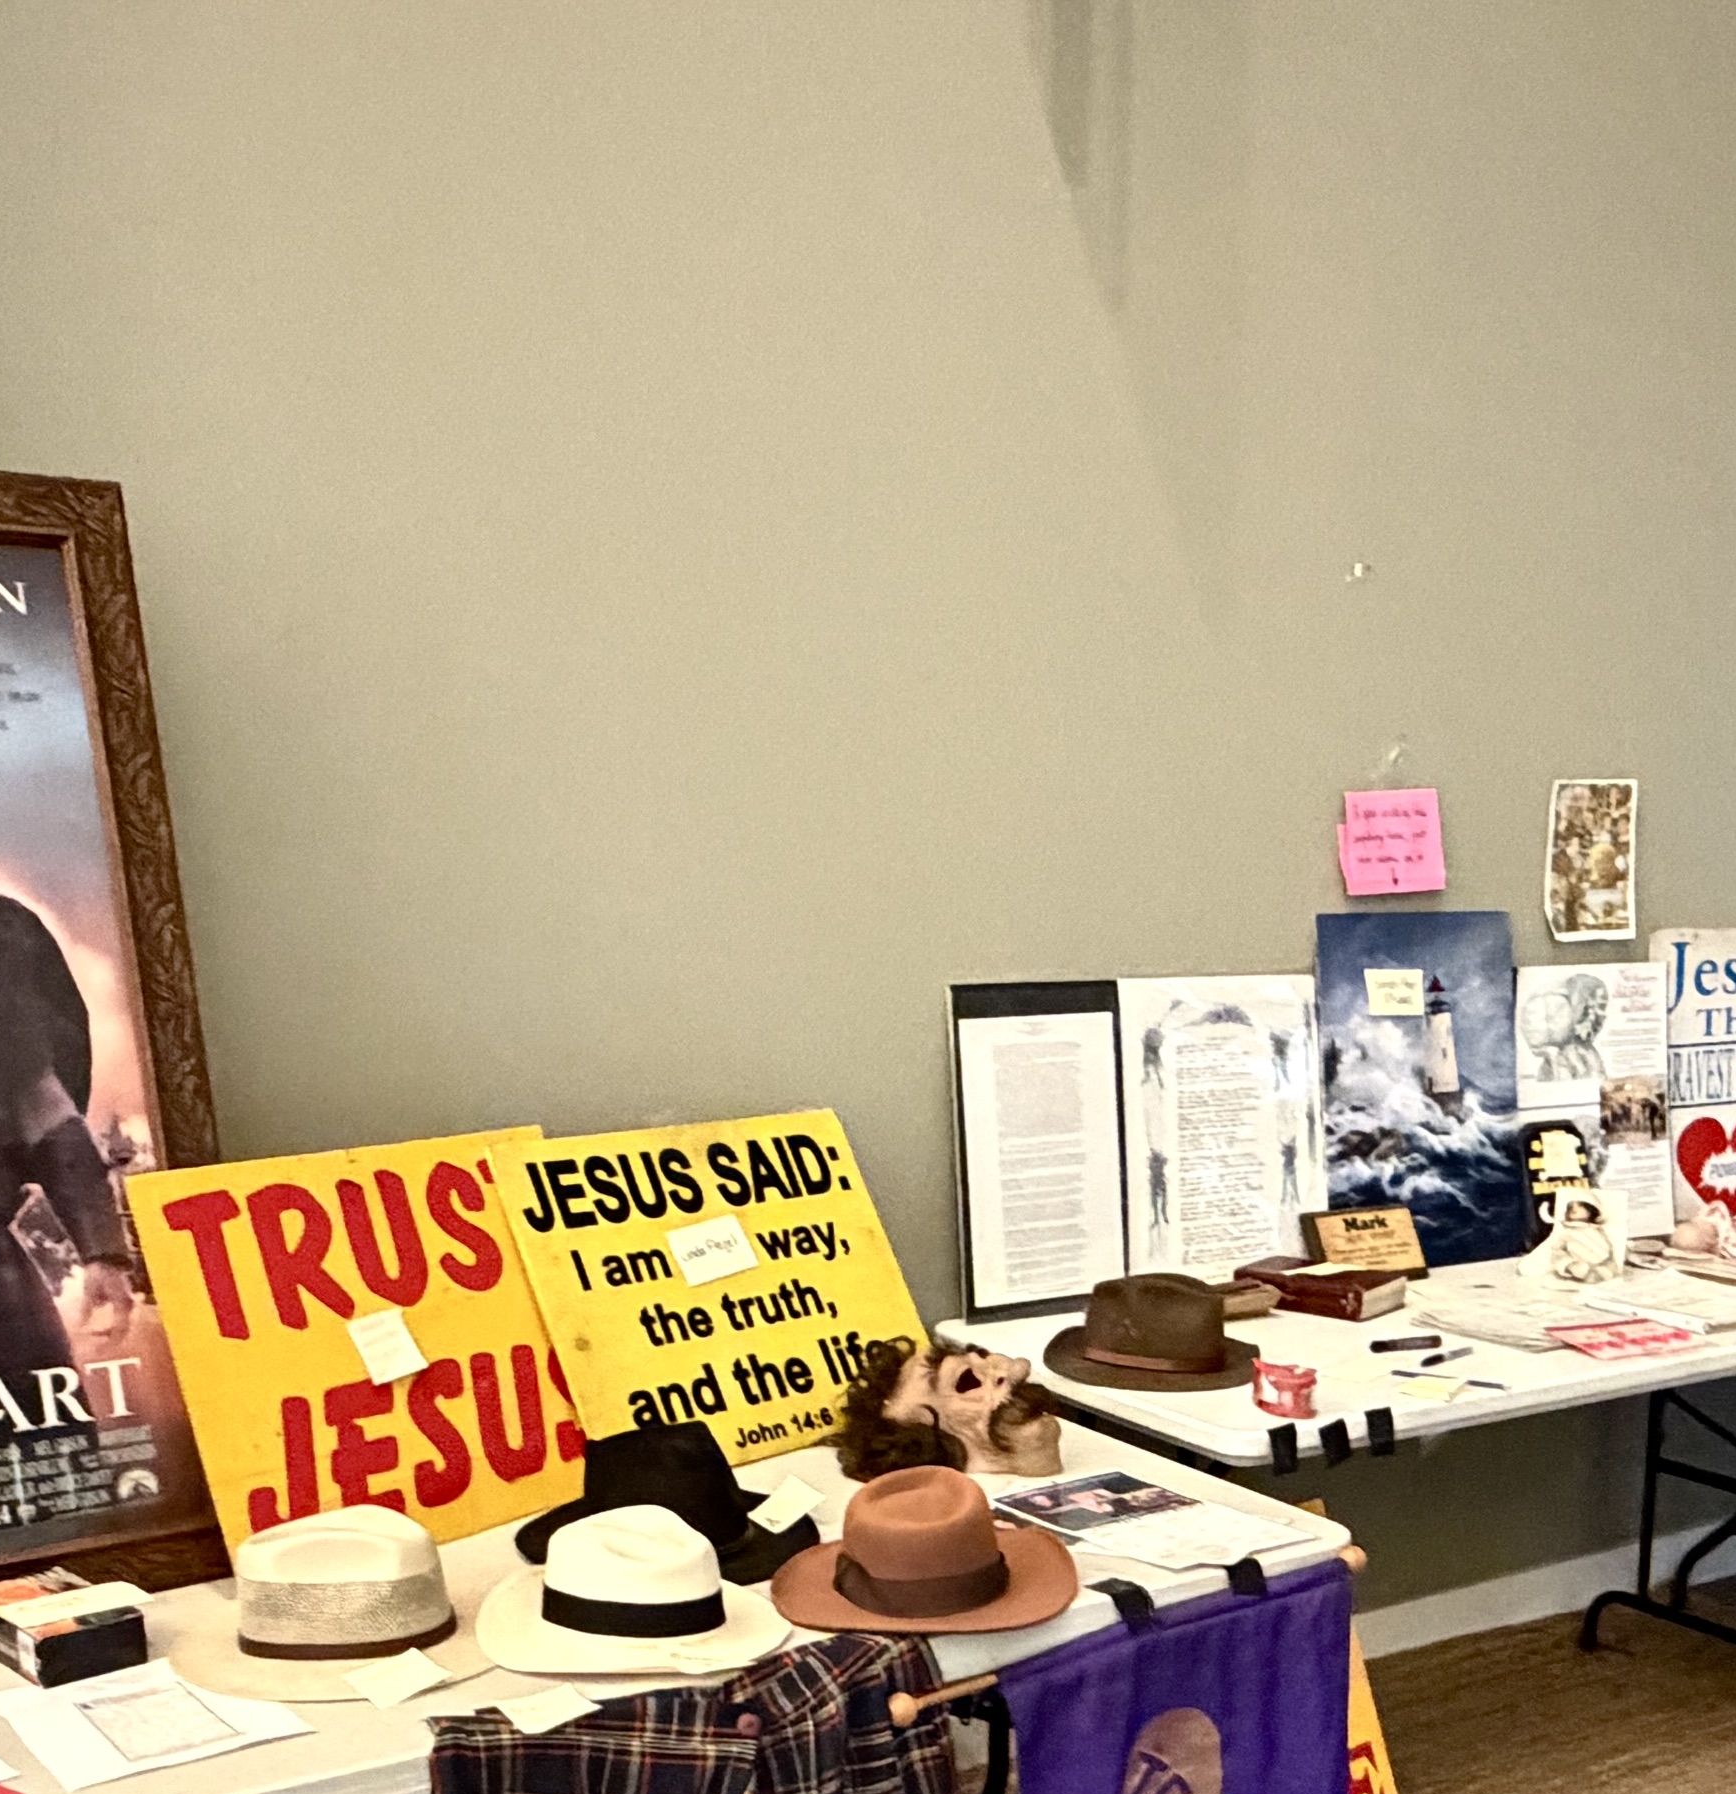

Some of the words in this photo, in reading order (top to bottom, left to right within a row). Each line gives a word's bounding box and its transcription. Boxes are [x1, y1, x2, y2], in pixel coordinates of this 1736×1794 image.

[1668, 1047, 1736, 1101] RAVEST
[523, 1146, 704, 1233] JESUS
[705, 1133, 853, 1205] SAID:
[162, 1158, 504, 1341] TRUS
[570, 1249, 592, 1291] I
[601, 1248, 672, 1288] am
[755, 1220, 852, 1262] way,
[639, 1303, 715, 1347] the
[720, 1280, 838, 1333] truth,
[627, 1362, 729, 1430] and
[731, 1353, 815, 1406] the
[817, 1331, 873, 1385] lif
[735, 1421, 788, 1449] John
[789, 1406, 834, 1434] 14:6
